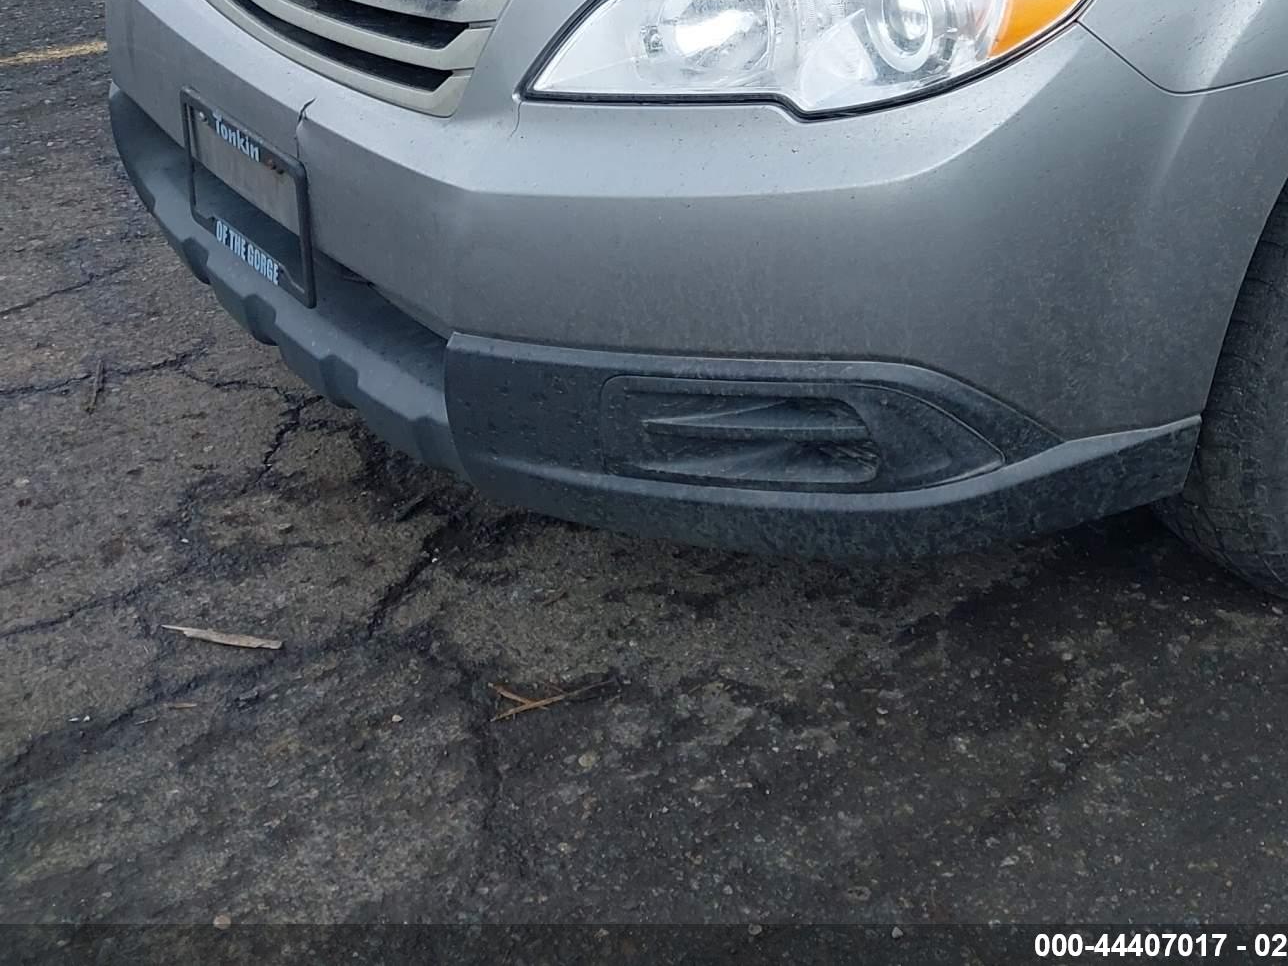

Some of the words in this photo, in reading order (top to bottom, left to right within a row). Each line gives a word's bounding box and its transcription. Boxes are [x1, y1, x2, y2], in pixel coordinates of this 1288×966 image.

[213, 112, 260, 162] Tonkin
[215, 220, 229, 246] OF
[229, 230, 247, 262] THE
[247, 242, 280, 285] GORGE
